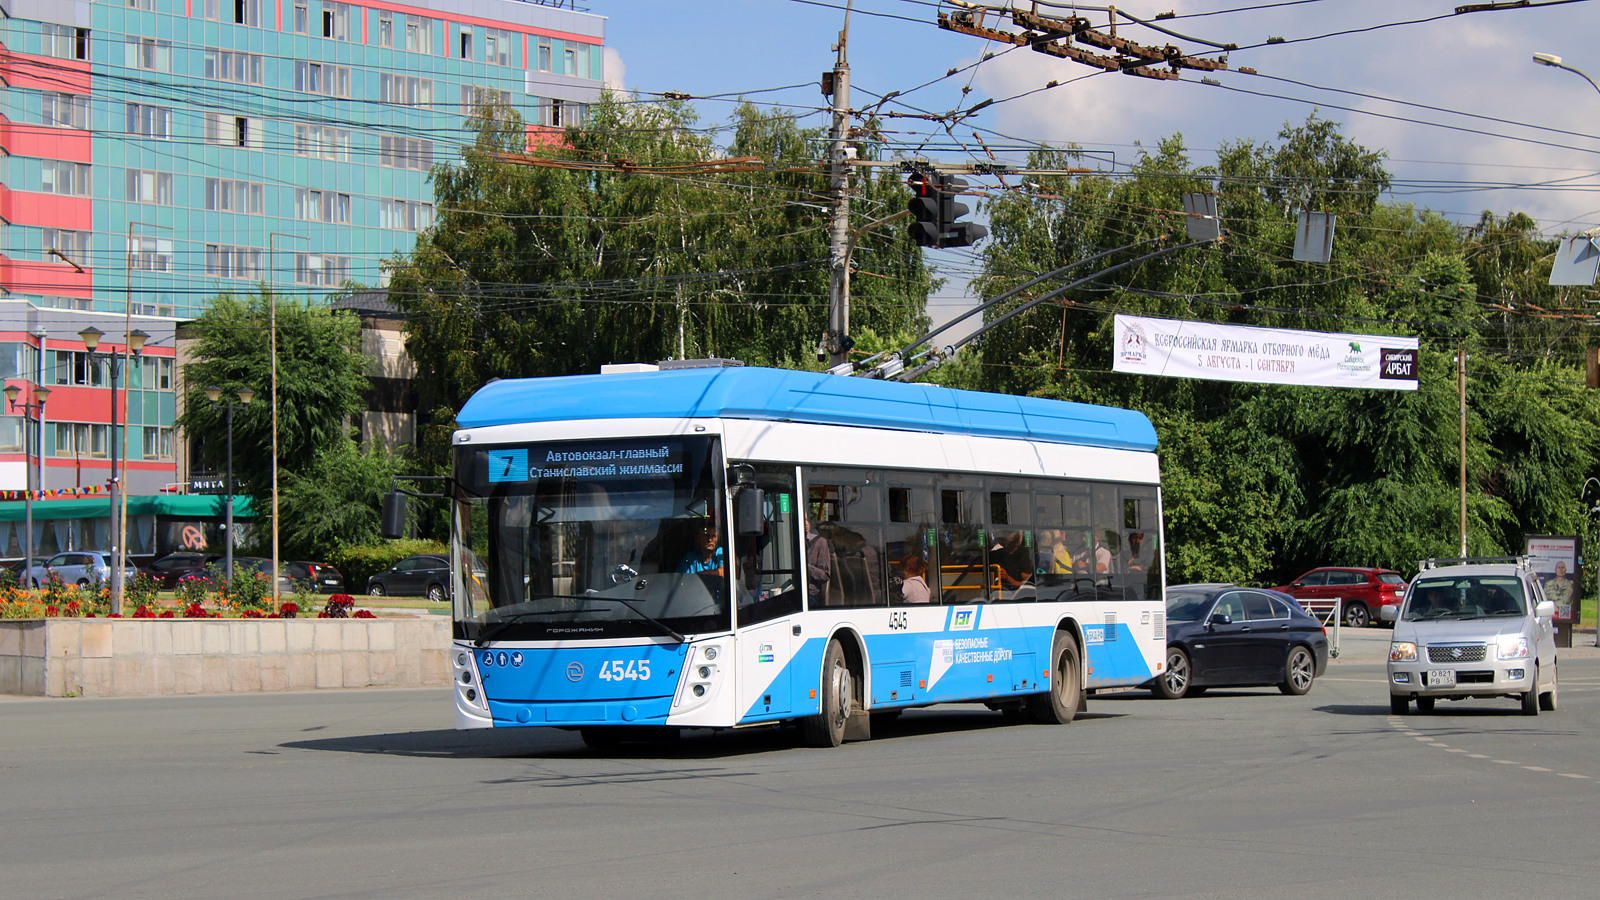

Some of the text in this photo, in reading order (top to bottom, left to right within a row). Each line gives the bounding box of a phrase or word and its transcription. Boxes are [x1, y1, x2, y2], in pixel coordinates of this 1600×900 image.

[1154, 333, 1331, 359] ВСЕРОССИЙСКАЯ ЯРМАРКА ОТБОРНОГО МЁДА
[1206, 355, 1241, 369] АВГУСТА
[1257, 359, 1295, 373] СЕНТЯБРЯ
[1385, 363, 1412, 376] АРБАТ
[546, 446, 669, 462] Автовокзал-главный
[500, 456, 514, 477] 7
[529, 463, 616, 478] Станиславский
[193, 480, 224, 489] МЯТА
[889, 612, 907, 630] 4545
[955, 637, 988, 650] БЕЗОПАСНЫЕ
[955, 650, 993, 664] КАЧЕСТВЕННЫЕ
[993, 649, 1013, 664] ДОРОГИ
[599, 659, 651, 681] 4545
